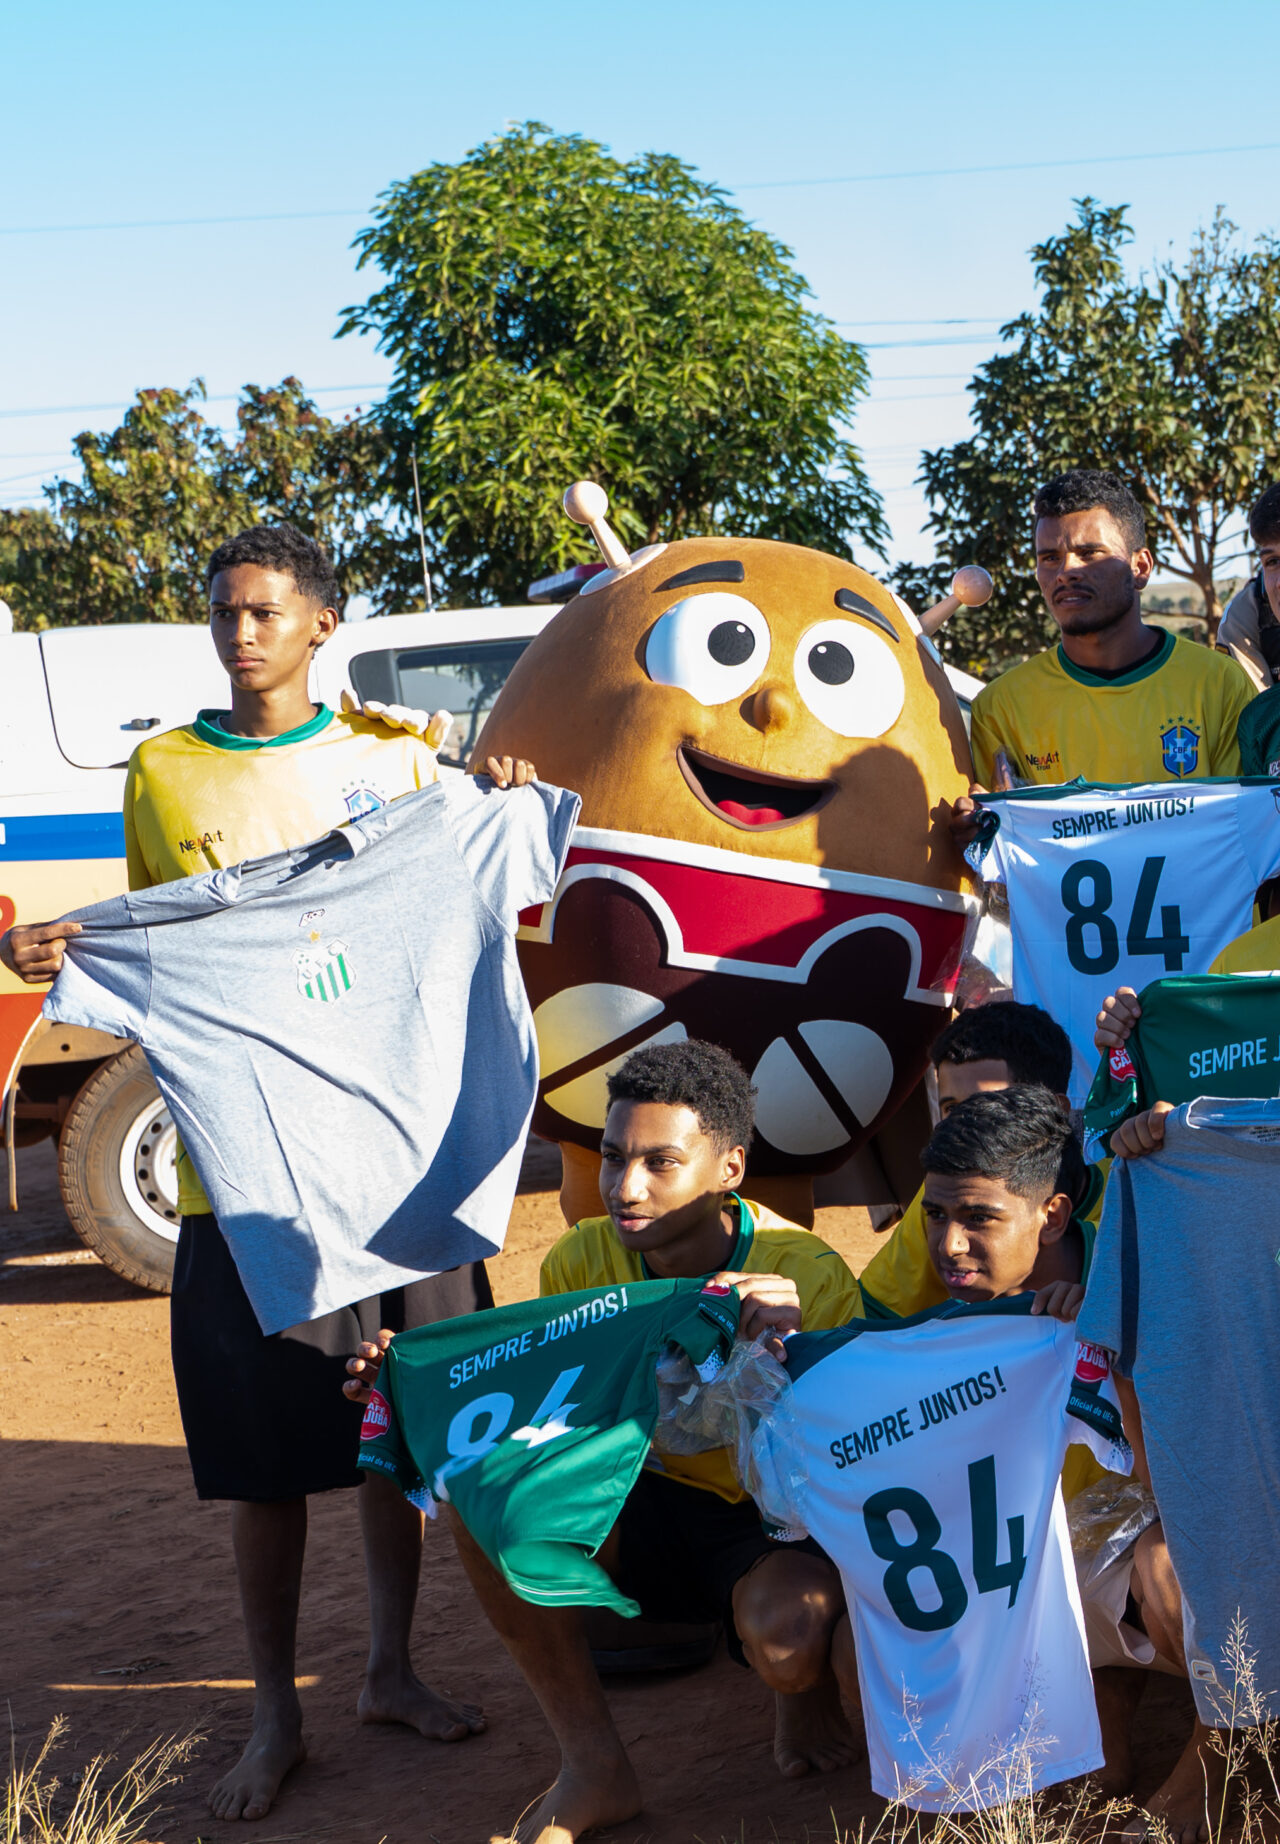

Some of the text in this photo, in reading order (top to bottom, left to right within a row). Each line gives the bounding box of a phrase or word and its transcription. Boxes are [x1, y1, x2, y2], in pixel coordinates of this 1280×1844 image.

[1172, 746, 1188, 754] CBF
[1052, 796, 1195, 840] SEMPRE JUNTOS!
[1060, 856, 1190, 976] 84
[1189, 1037, 1267, 1079] SEMPRE
[449, 1287, 629, 1389] SEMPRE JUNTOS!
[830, 1365, 1008, 1469] SEMPRE JUNTOS!
[1069, 1396, 1115, 1424] Oficial do UEC
[862, 1454, 1028, 1632] 84
